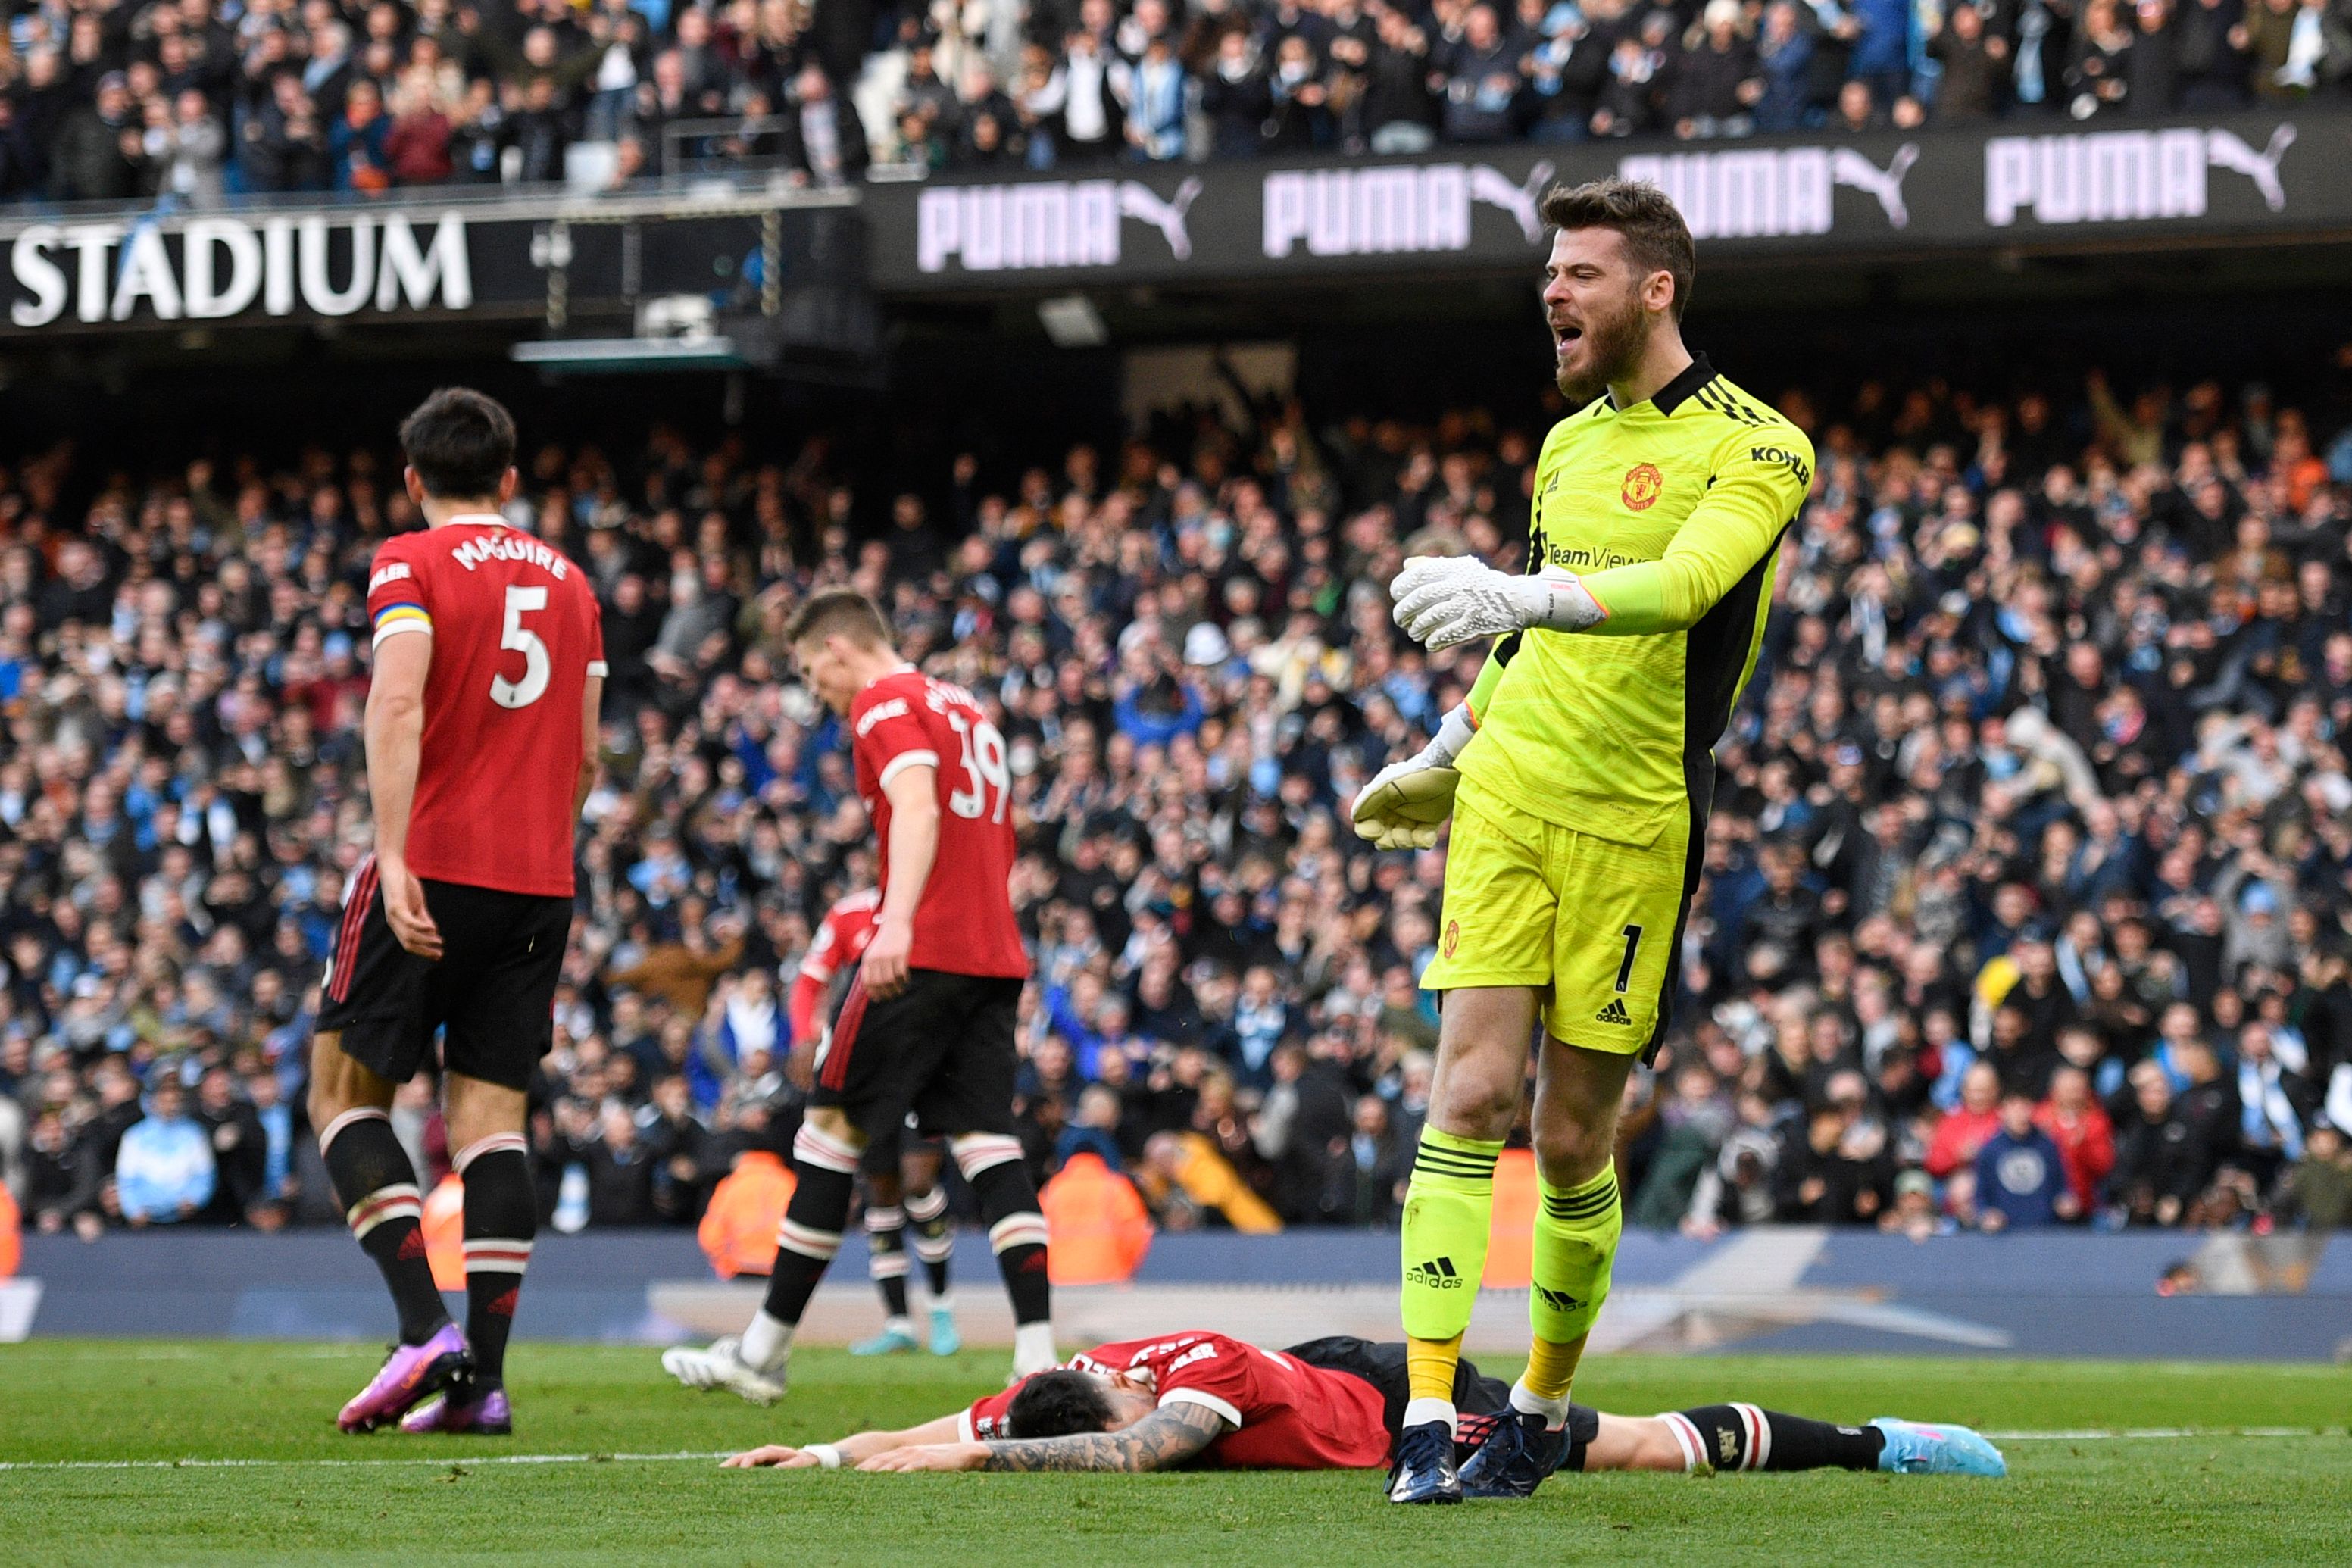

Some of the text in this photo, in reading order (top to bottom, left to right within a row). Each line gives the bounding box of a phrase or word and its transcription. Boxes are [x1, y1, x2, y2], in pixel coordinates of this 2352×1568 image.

[1263, 163, 1472, 259] PUMA
[1985, 128, 2208, 226] PUMA
[10, 210, 473, 328] STADIUM
[917, 179, 1121, 273] PUMA
[451, 535, 568, 581] MAGUIRE
[1548, 543, 1650, 569] TeamView
[489, 583, 552, 710] 5
[947, 709, 1012, 825] 39
[1614, 923, 1643, 993] 1
[1595, 1013, 1632, 1026] adidas
[1406, 1272, 1463, 1289] adidas
